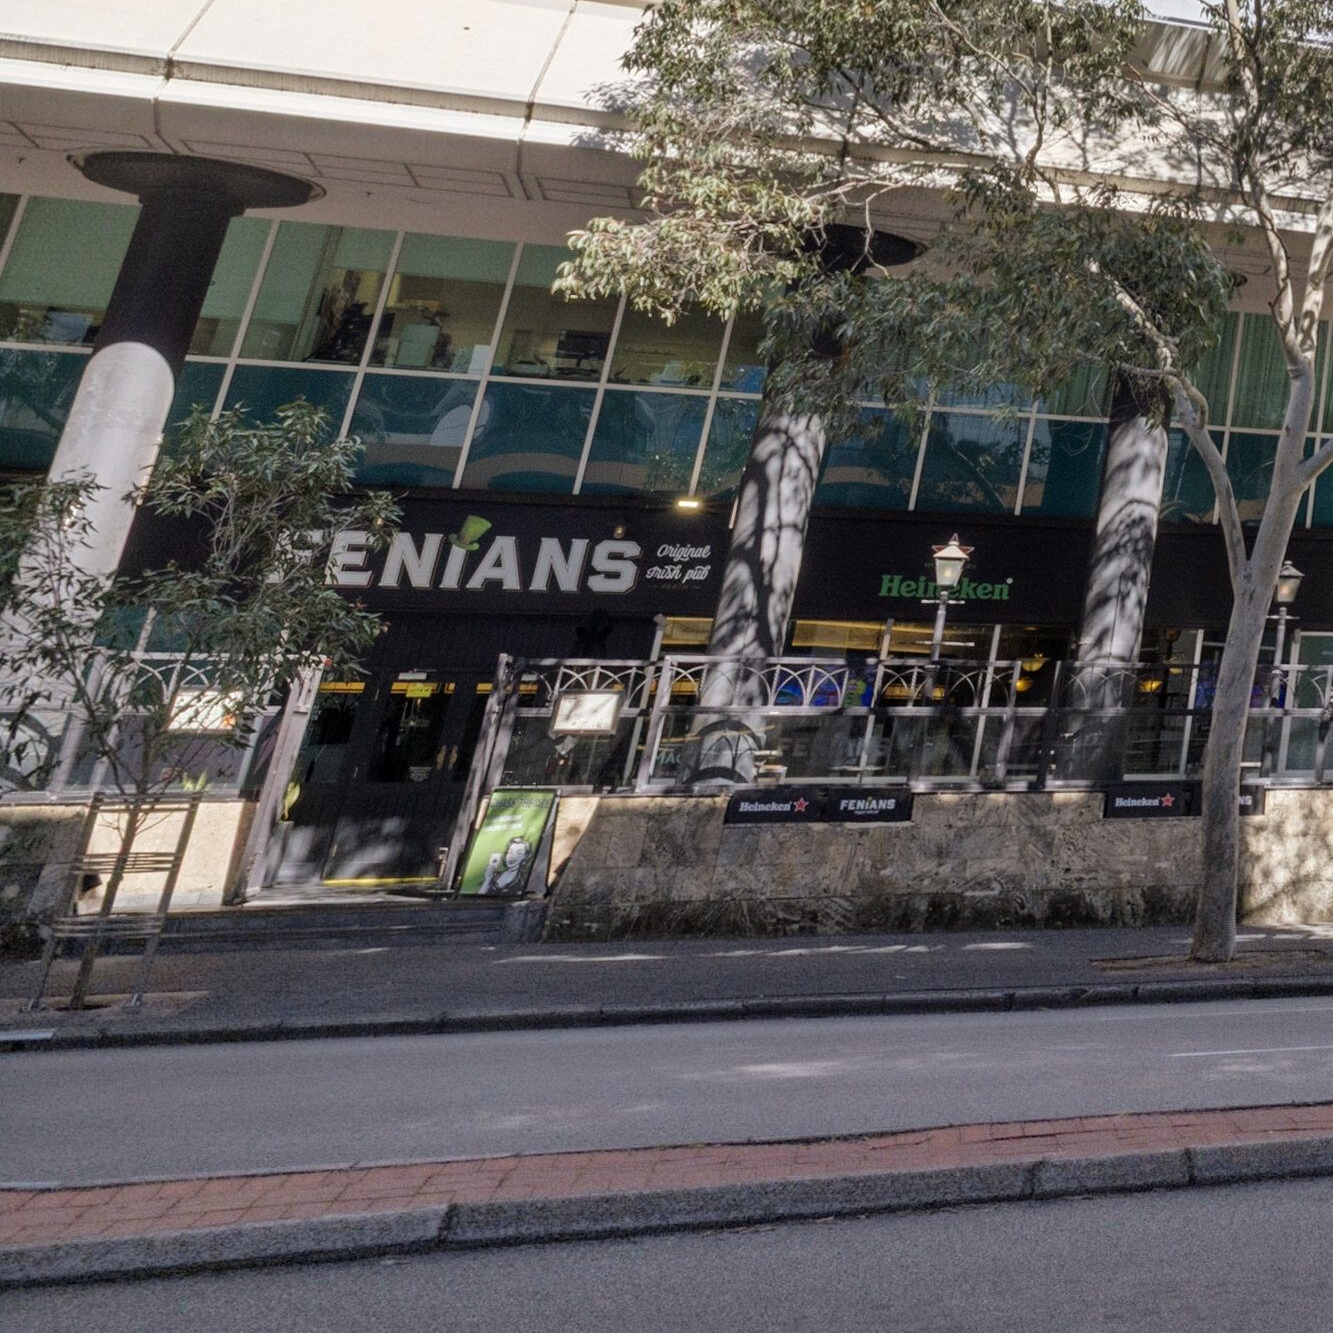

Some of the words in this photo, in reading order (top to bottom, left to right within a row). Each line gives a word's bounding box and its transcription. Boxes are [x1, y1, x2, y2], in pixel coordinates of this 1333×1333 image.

[657, 544, 711, 562] Original
[646, 564, 682, 580] Irish
[682, 565, 711, 584] pub
[738, 800, 792, 813] Heineken
[1114, 796, 1160, 807] Heineken
